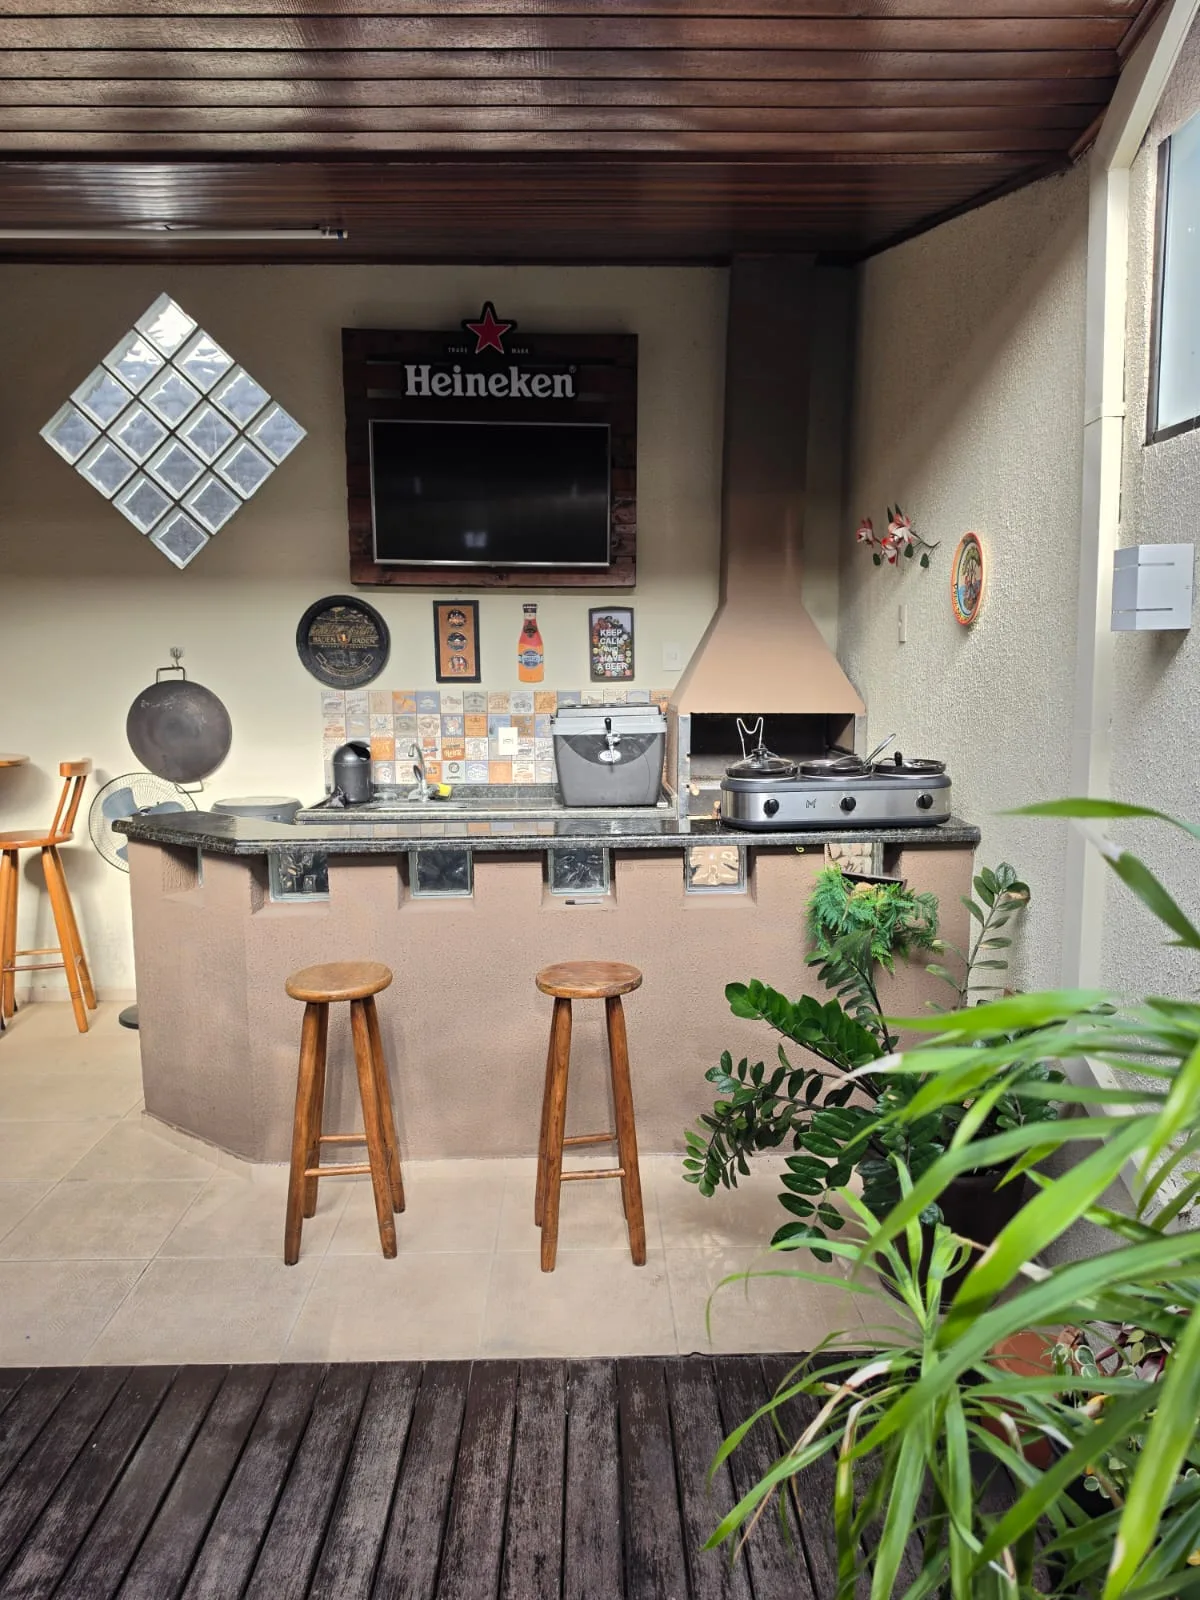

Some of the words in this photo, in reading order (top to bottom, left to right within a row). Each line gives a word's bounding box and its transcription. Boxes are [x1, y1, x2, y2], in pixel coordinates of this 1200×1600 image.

[511, 347, 529, 355] MARK
[404, 364, 576, 398] Heineken
[600, 629, 622, 637] KEEP
[600, 654, 624, 662] HAVE
[605, 662, 628, 670] BEER
